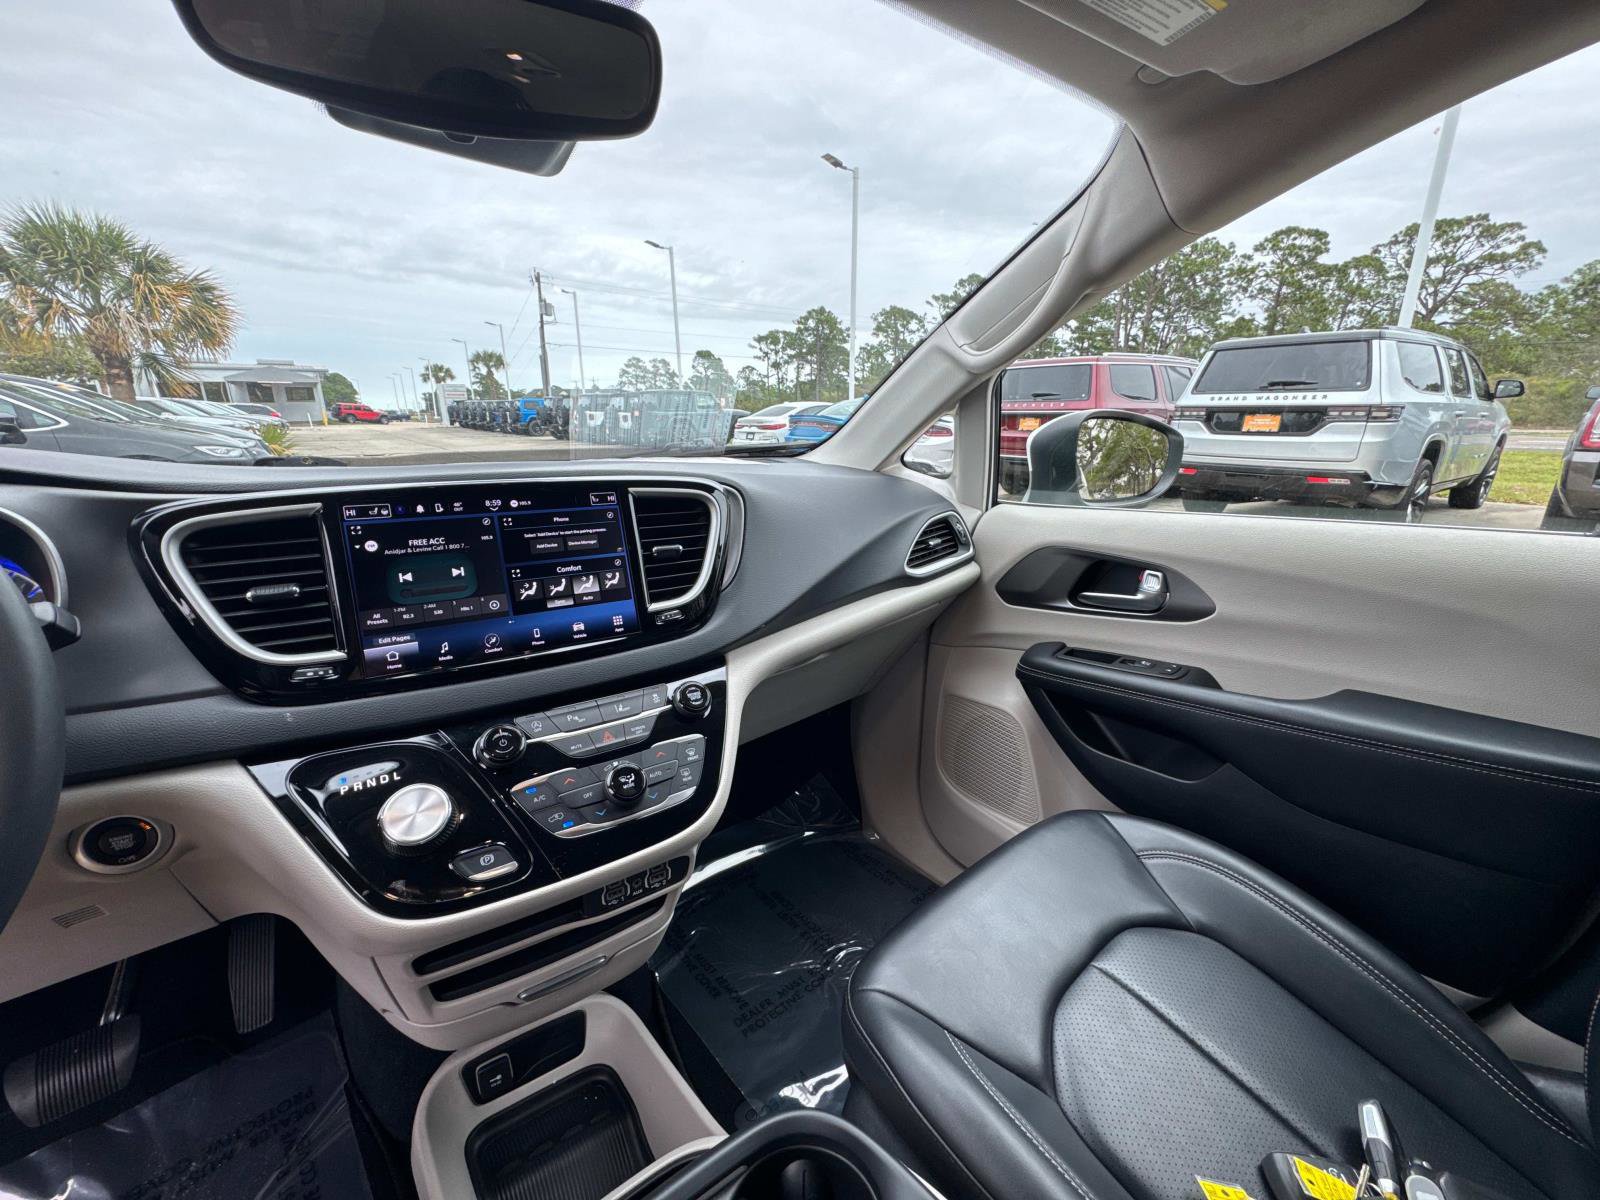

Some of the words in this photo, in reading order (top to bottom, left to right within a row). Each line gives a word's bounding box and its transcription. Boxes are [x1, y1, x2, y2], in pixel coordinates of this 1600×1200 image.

[485, 499, 501, 507] 8:59
[408, 538, 428, 546] FREE
[429, 537, 445, 545] ACC
[556, 565, 582, 573] Comfort
[392, 635, 411, 643] Pages
[533, 794, 546, 802] A/C
[734, 998, 774, 1028] DEALER
